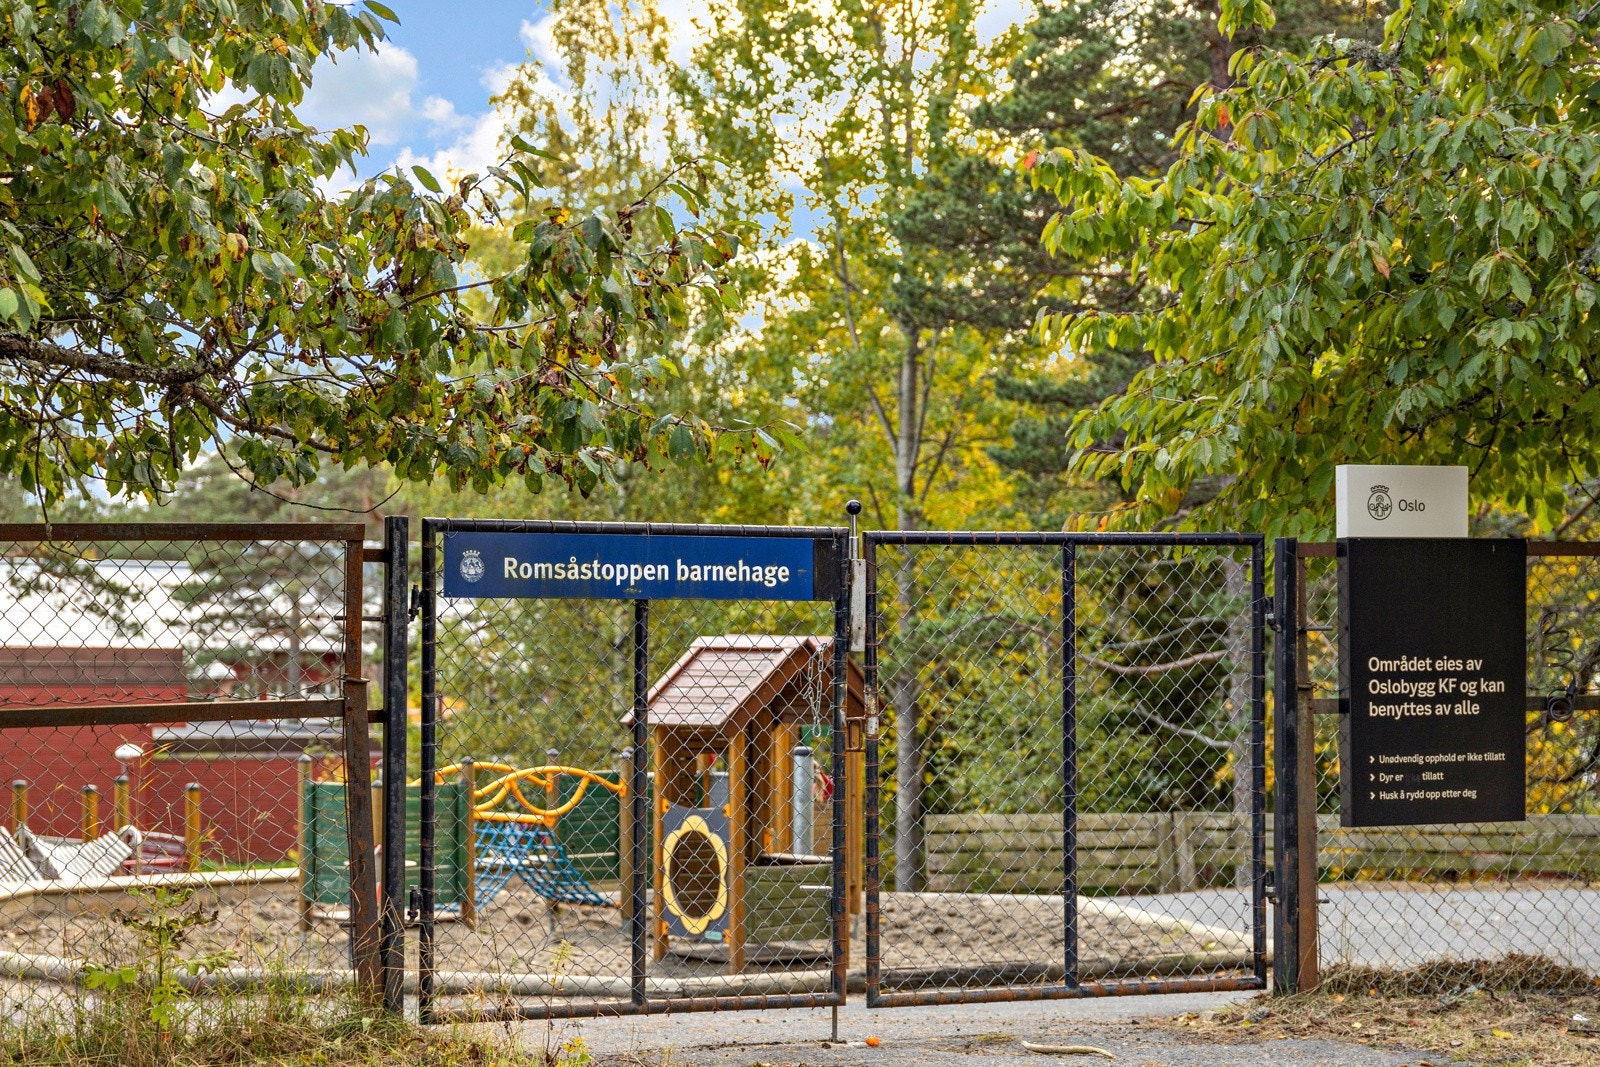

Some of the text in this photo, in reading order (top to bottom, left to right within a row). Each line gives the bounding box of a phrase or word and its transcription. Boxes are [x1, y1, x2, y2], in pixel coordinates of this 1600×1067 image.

[1398, 499, 1426, 512] Oslo
[503, 556, 669, 587] Romsåstoppen
[676, 558, 790, 587] barnehage
[1368, 655, 1483, 672] Området eies av
[1368, 678, 1505, 698] Oslobygg KF og kan
[1369, 700, 1480, 720] benyttes av alle
[1379, 754, 1424, 764] Unødvendig
[1425, 753, 1456, 764] opphold
[1467, 753, 1483, 761] ikke
[1484, 752, 1506, 761] tillatt
[1379, 773, 1394, 783] Dyr
[1422, 772, 1444, 780] tillatt
[1379, 789, 1478, 800] Husk å rydd opp etter deg
